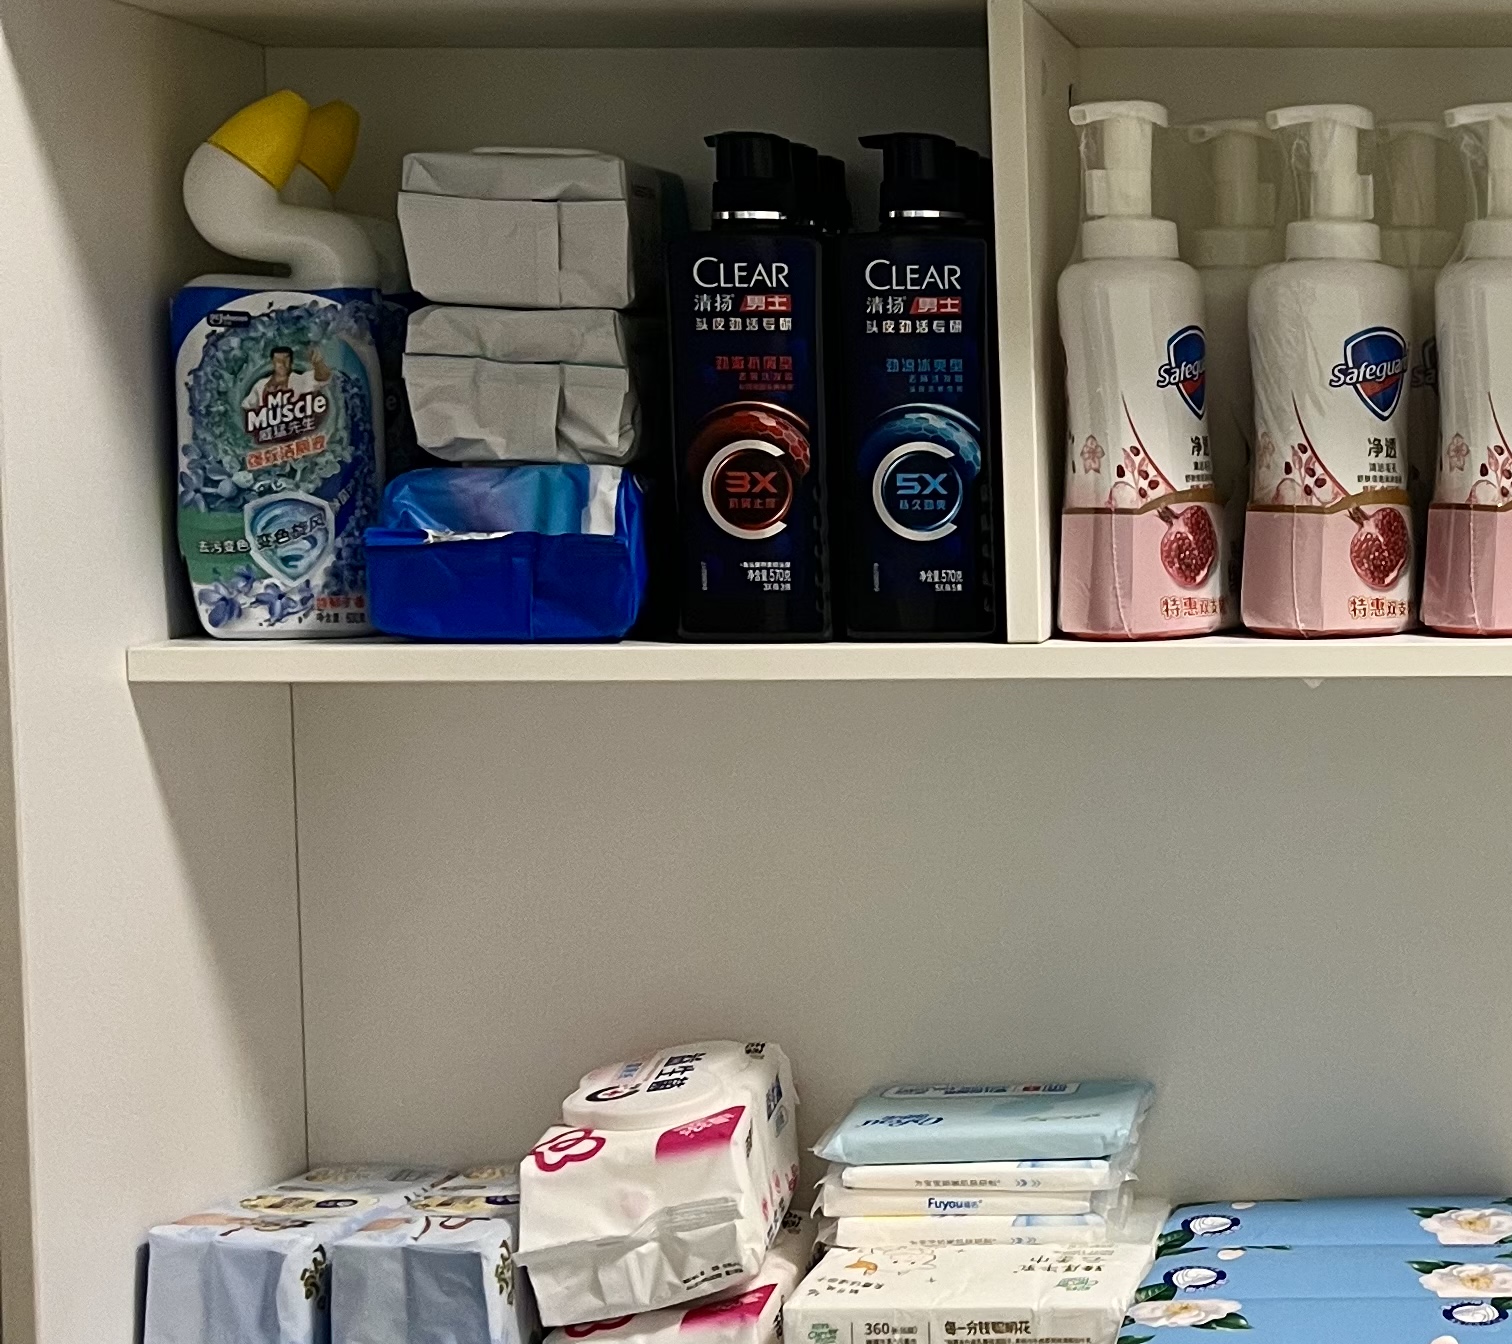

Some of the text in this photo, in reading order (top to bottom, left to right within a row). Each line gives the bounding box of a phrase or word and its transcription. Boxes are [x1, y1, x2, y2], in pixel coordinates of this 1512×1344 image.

[692, 256, 790, 288] CLEAR
[864, 259, 962, 290] CLEAR
[693, 293, 788, 312] 清扬 男士
[866, 295, 960, 314] 清扬 男士
[267, 391, 293, 408] Mr
[246, 394, 328, 432] Muscle
[726, 471, 778, 493] 3X
[896, 473, 948, 495] 5X
[927, 1196, 963, 1211] Fuyou
